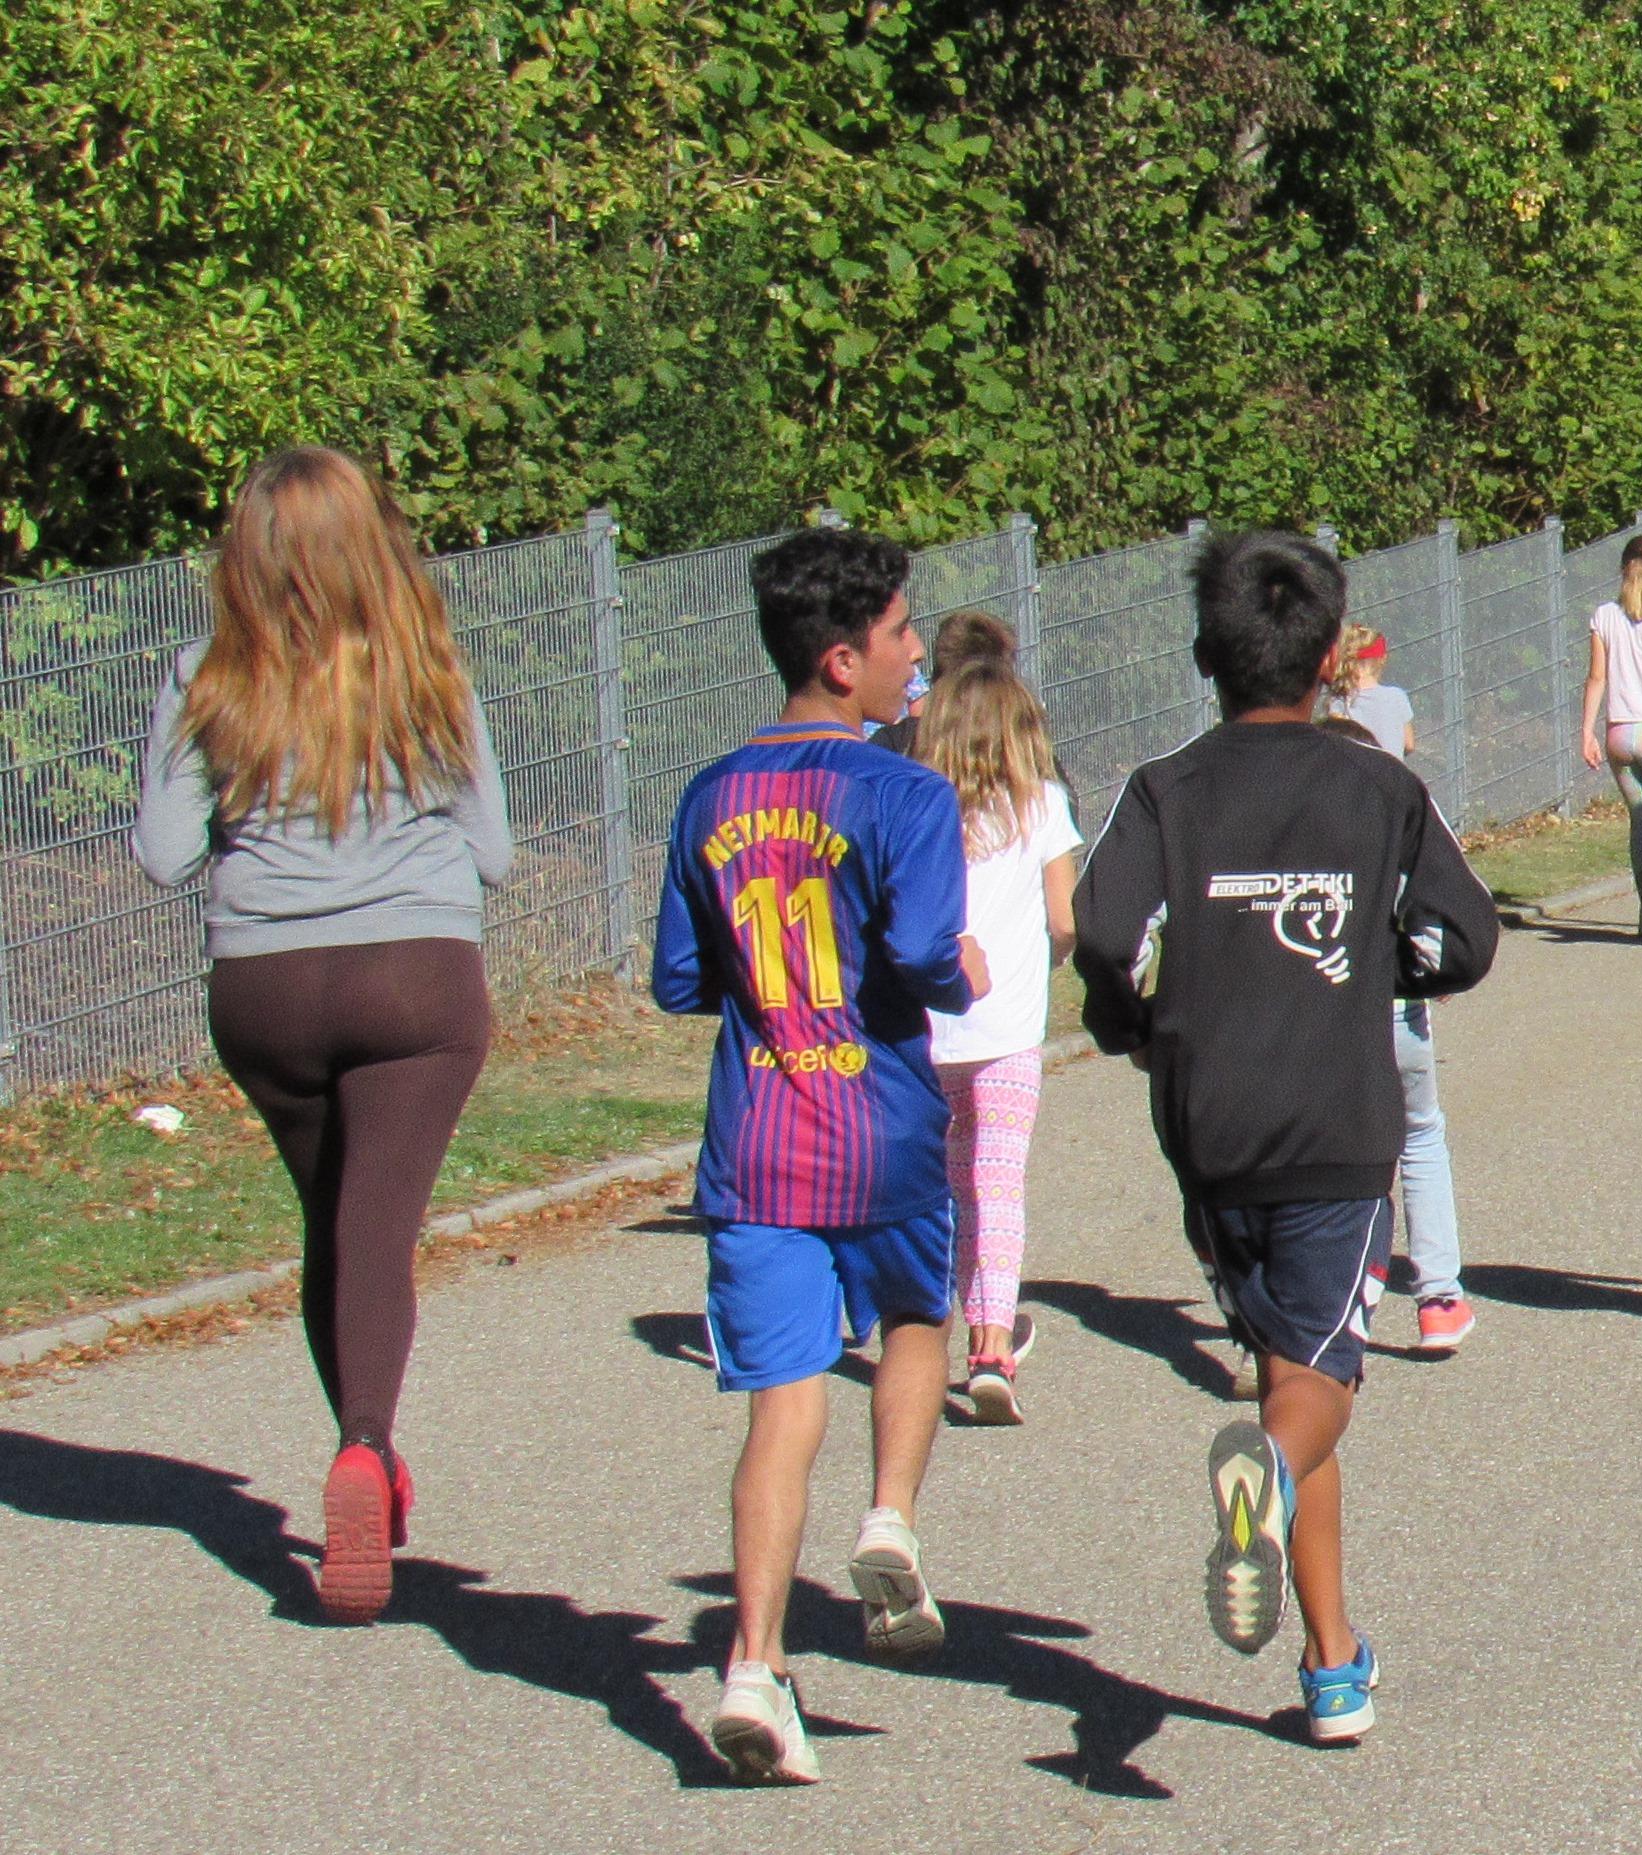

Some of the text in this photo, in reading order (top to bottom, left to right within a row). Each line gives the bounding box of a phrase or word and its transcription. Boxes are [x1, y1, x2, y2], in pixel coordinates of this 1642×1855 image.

[1299, 901, 1322, 911] am
[732, 876, 844, 1010] 11
[750, 1044, 828, 1075] ucef
